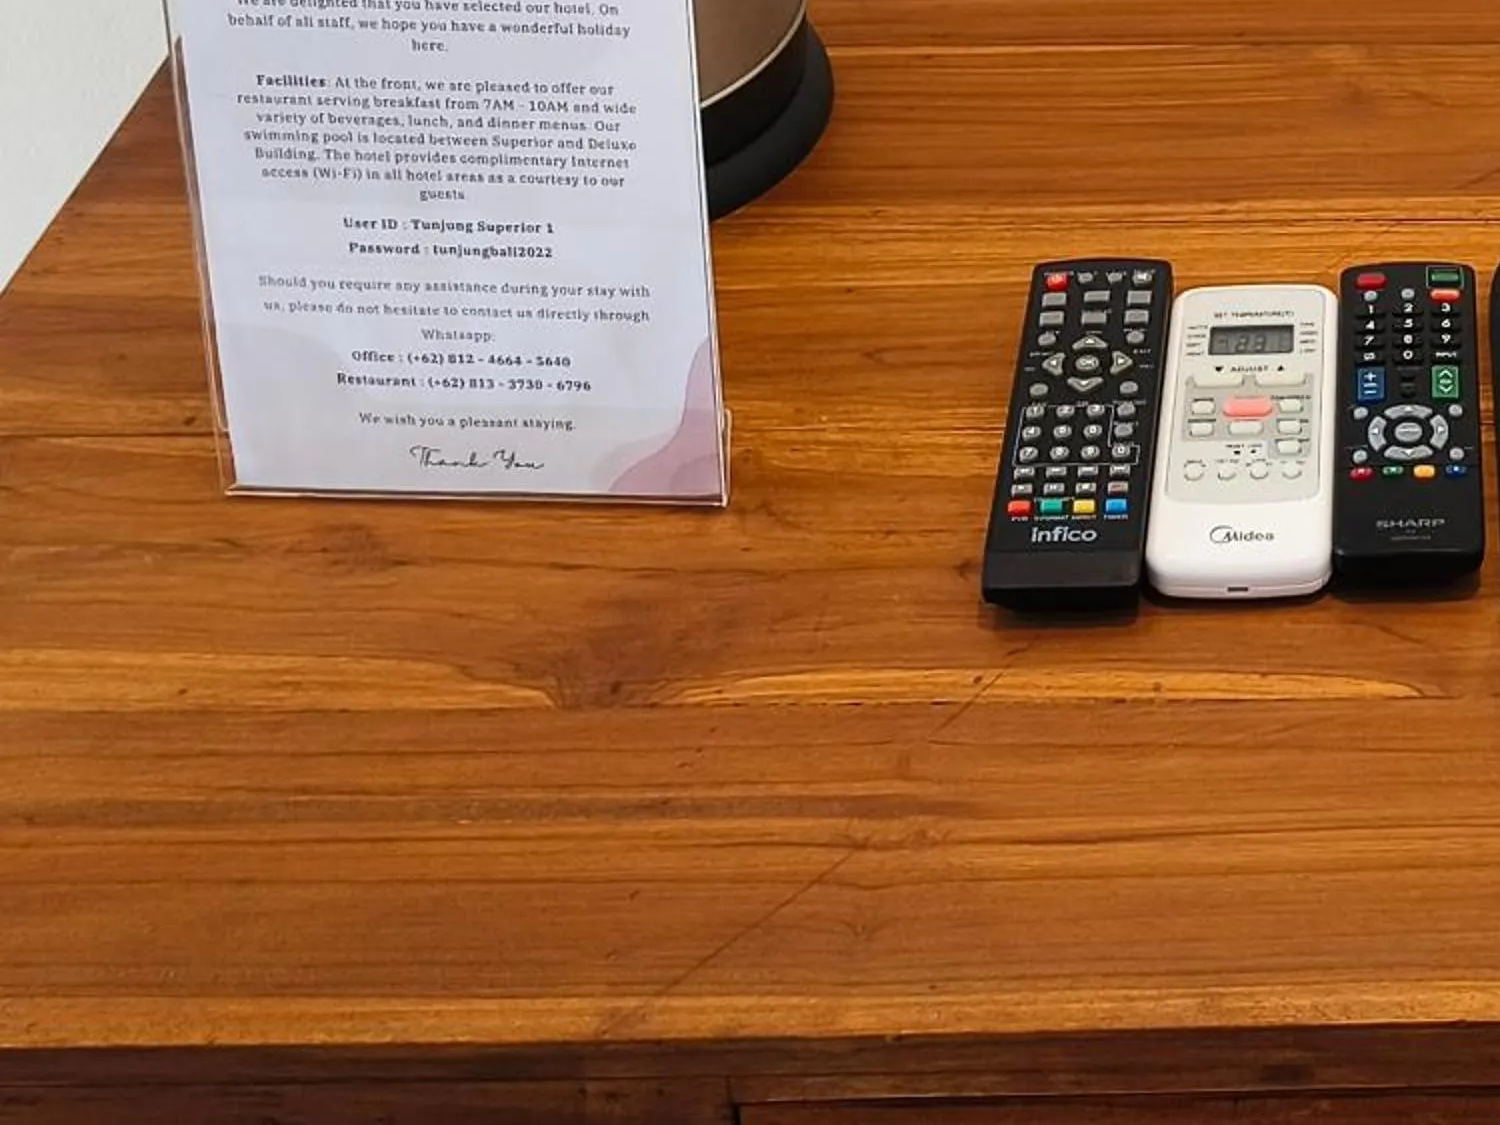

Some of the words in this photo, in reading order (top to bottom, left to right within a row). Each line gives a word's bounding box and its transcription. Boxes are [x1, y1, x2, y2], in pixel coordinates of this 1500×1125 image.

[394, 0, 421, 12] you
[525, 2, 551, 13] our
[598, 2, 619, 15] On
[226, 13, 274, 27] behalf
[276, 14, 292, 28] of
[294, 15, 314, 28] all
[357, 19, 380, 30] we
[380, 17, 417, 33] hope
[420, 20, 447, 33] you
[450, 18, 486, 32] have
[487, 22, 497, 32] a
[498, 20, 576, 34] wonderful
[576, 21, 630, 38] holiday
[334, 76, 350, 89] At
[353, 77, 377, 90] the
[424, 81, 445, 91] we
[448, 81, 472, 92] are
[475, 79, 532, 96] pleased
[532, 81, 549, 94] to
[551, 81, 586, 95] offer
[588, 84, 614, 95] our
[236, 91, 313, 106] restaurant
[316, 93, 371, 110] serving
[372, 95, 441, 109] breakfast
[444, 96, 480, 110] from
[482, 97, 515, 111] 7AM
[527, 98, 569, 112] 10AM
[572, 100, 600, 113] and
[602, 100, 636, 114] wide
[256, 110, 306, 126] variety
[310, 111, 324, 125] of
[408, 114, 453, 129] lunch,
[457, 115, 484, 128] and
[487, 116, 535, 130] dinner
[593, 118, 620, 132] Our
[243, 127, 320, 144] swimming
[322, 129, 353, 145] pool
[357, 130, 371, 143] is
[372, 130, 425, 145] located
[426, 132, 489, 146] between
[491, 134, 554, 150] Superior
[557, 135, 584, 149] and
[587, 136, 637, 150] Deluxe
[322, 148, 350, 162] The
[354, 149, 390, 163] hotel
[394, 150, 456, 166] provides
[459, 151, 567, 169] complimentary
[571, 154, 628, 168] Internet
[261, 167, 309, 179] access
[312, 166, 363, 182] (Wi-Fi)
[364, 167, 381, 181] in
[383, 168, 402, 181] all
[405, 168, 443, 182] hotel
[444, 172, 485, 183] areas
[487, 172, 504, 183] as
[507, 173, 517, 184] a
[518, 171, 581, 187] courtesy
[582, 173, 599, 185] to
[600, 175, 625, 186] our
[343, 216, 378, 229] User
[380, 217, 398, 230] ID
[409, 217, 474, 234] Tunjung
[476, 219, 542, 235] Superior
[546, 221, 554, 233] 1
[348, 241, 421, 255] Password
[430, 243, 555, 260] tunjungbali2022
[309, 279, 335, 292] you
[339, 277, 391, 293] require
[395, 281, 420, 294] any
[425, 279, 497, 294] assistance
[500, 281, 548, 298] during
[550, 285, 583, 298] your
[586, 284, 616, 299] stay
[618, 284, 650, 298] with
[288, 299, 333, 315] please
[335, 300, 354, 313] do
[356, 301, 380, 314] not
[382, 301, 440, 315] hesitate
[442, 303, 459, 316] to
[460, 304, 512, 317] contact
[516, 307, 533, 318] us
[535, 305, 590, 322] directly
[593, 307, 650, 323] through
[351, 349, 395, 363] Office
[487, 352, 523, 366] 4664
[336, 371, 416, 386] Restaurant
[556, 377, 591, 391] 6796
[358, 411, 381, 424] We
[418, 415, 445, 428] you
[446, 415, 456, 426] a
[458, 413, 518, 430] pleasant
[409, 445, 488, 470] Thank
[493, 447, 545, 470] You
[1376, 518, 1445, 528] SHARP
[1031, 526, 1097, 542] infico
[1213, 526, 1275, 543] Midea
